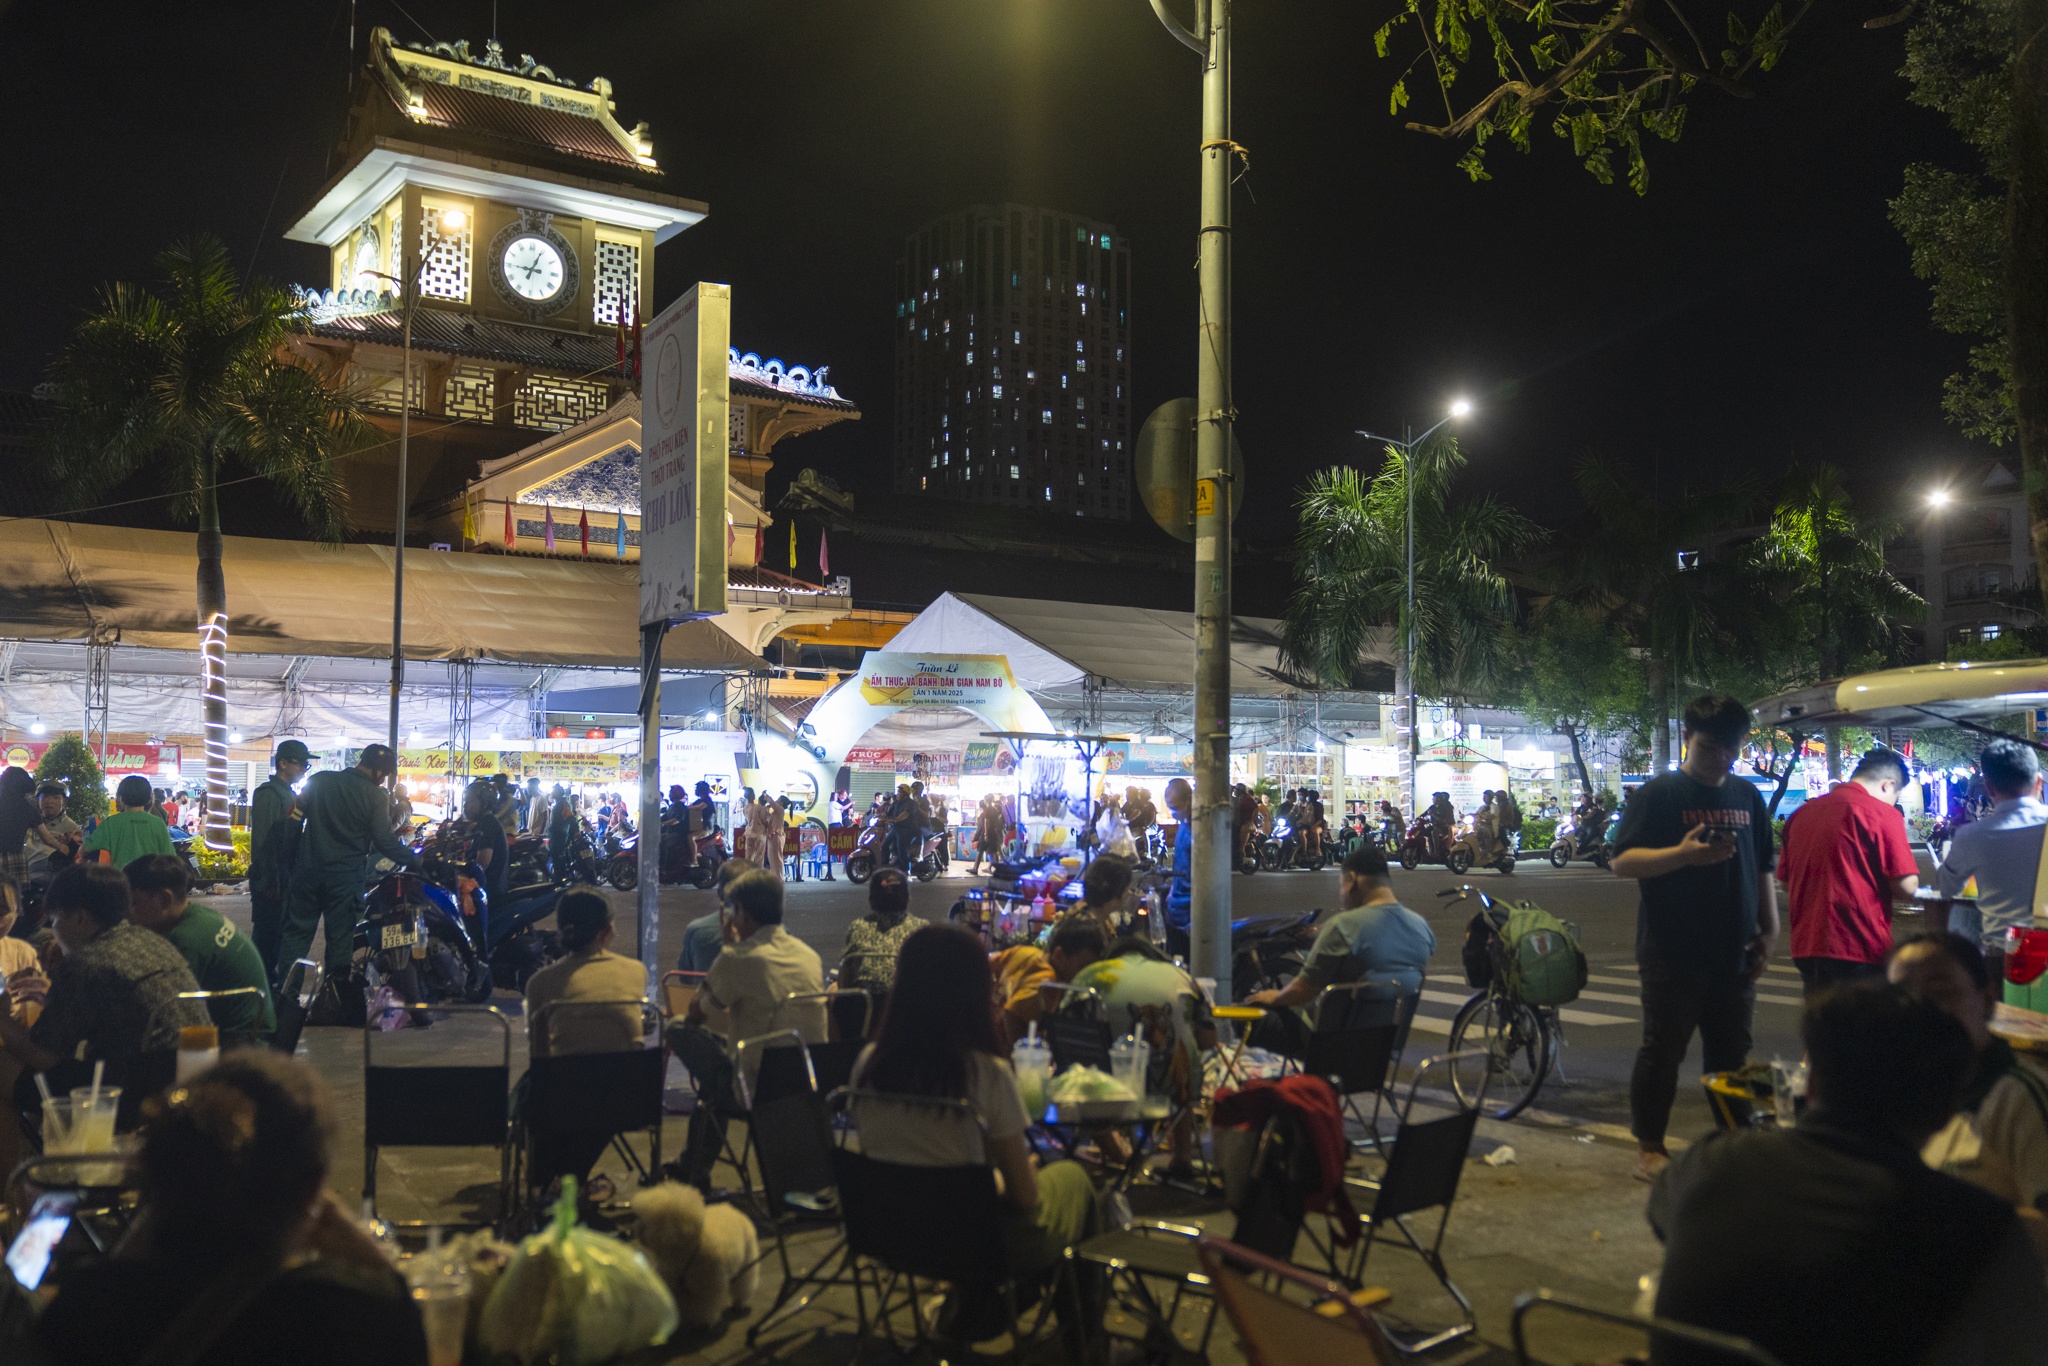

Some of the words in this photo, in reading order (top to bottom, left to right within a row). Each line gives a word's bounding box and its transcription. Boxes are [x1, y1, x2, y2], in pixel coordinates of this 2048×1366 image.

[662, 434, 674, 457] PHỤ
[674, 425, 688, 450] KIỆN
[666, 454, 686, 480] TRANG
[645, 491, 667, 536] CHỢ
[670, 478, 692, 526] LỚN
[946, 664, 959, 673] Lễ
[885, 676, 904, 688] THỰC
[906, 676, 916, 687] VÀ
[918, 675, 938, 687] BÁNH
[940, 675, 954, 687] DÂN
[957, 678, 973, 687] GIAN
[976, 678, 991, 688] NAM
[993, 676, 1003, 689] BỘ
[830, 831, 852, 849] CẤM
